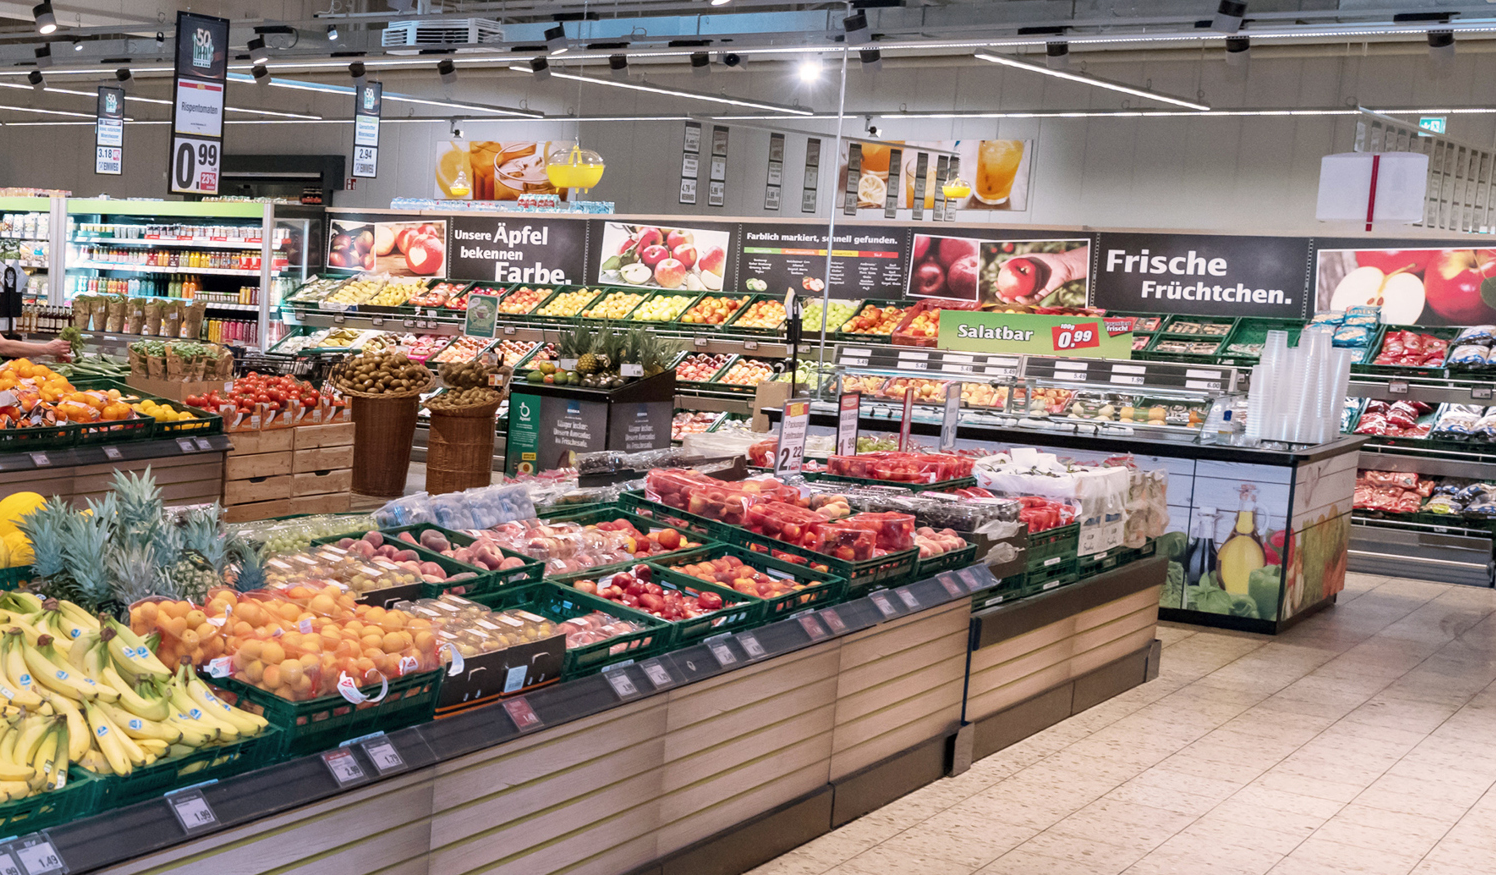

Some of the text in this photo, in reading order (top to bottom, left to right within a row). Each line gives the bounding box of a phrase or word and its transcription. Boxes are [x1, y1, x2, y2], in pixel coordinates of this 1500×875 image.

[197, 28, 210, 47] 50
[181, 102, 218, 115] Rispentomaten
[98, 148, 113, 159] 3.18
[176, 142, 217, 190] 0.99
[201, 174, 216, 185] 23%
[454, 222, 548, 248] Unsere Äpfel
[746, 232, 780, 241] Farblich
[781, 233, 820, 243] markiert,
[854, 235, 898, 245] gefunden.
[460, 245, 523, 261] bekennen
[1106, 248, 1227, 276] Frische
[494, 261, 571, 285] Farbe.
[1141, 280, 1292, 305] Früchtchen.
[957, 324, 1034, 342] Salatbar
[1060, 323, 1075, 331] 100g
[1058, 330, 1093, 348] 0.99
[779, 446, 802, 472] 2.22
[384, 753, 404, 766] 1.79
[194, 810, 212, 823] 1.99
[38, 855, 59, 867] 1.49
